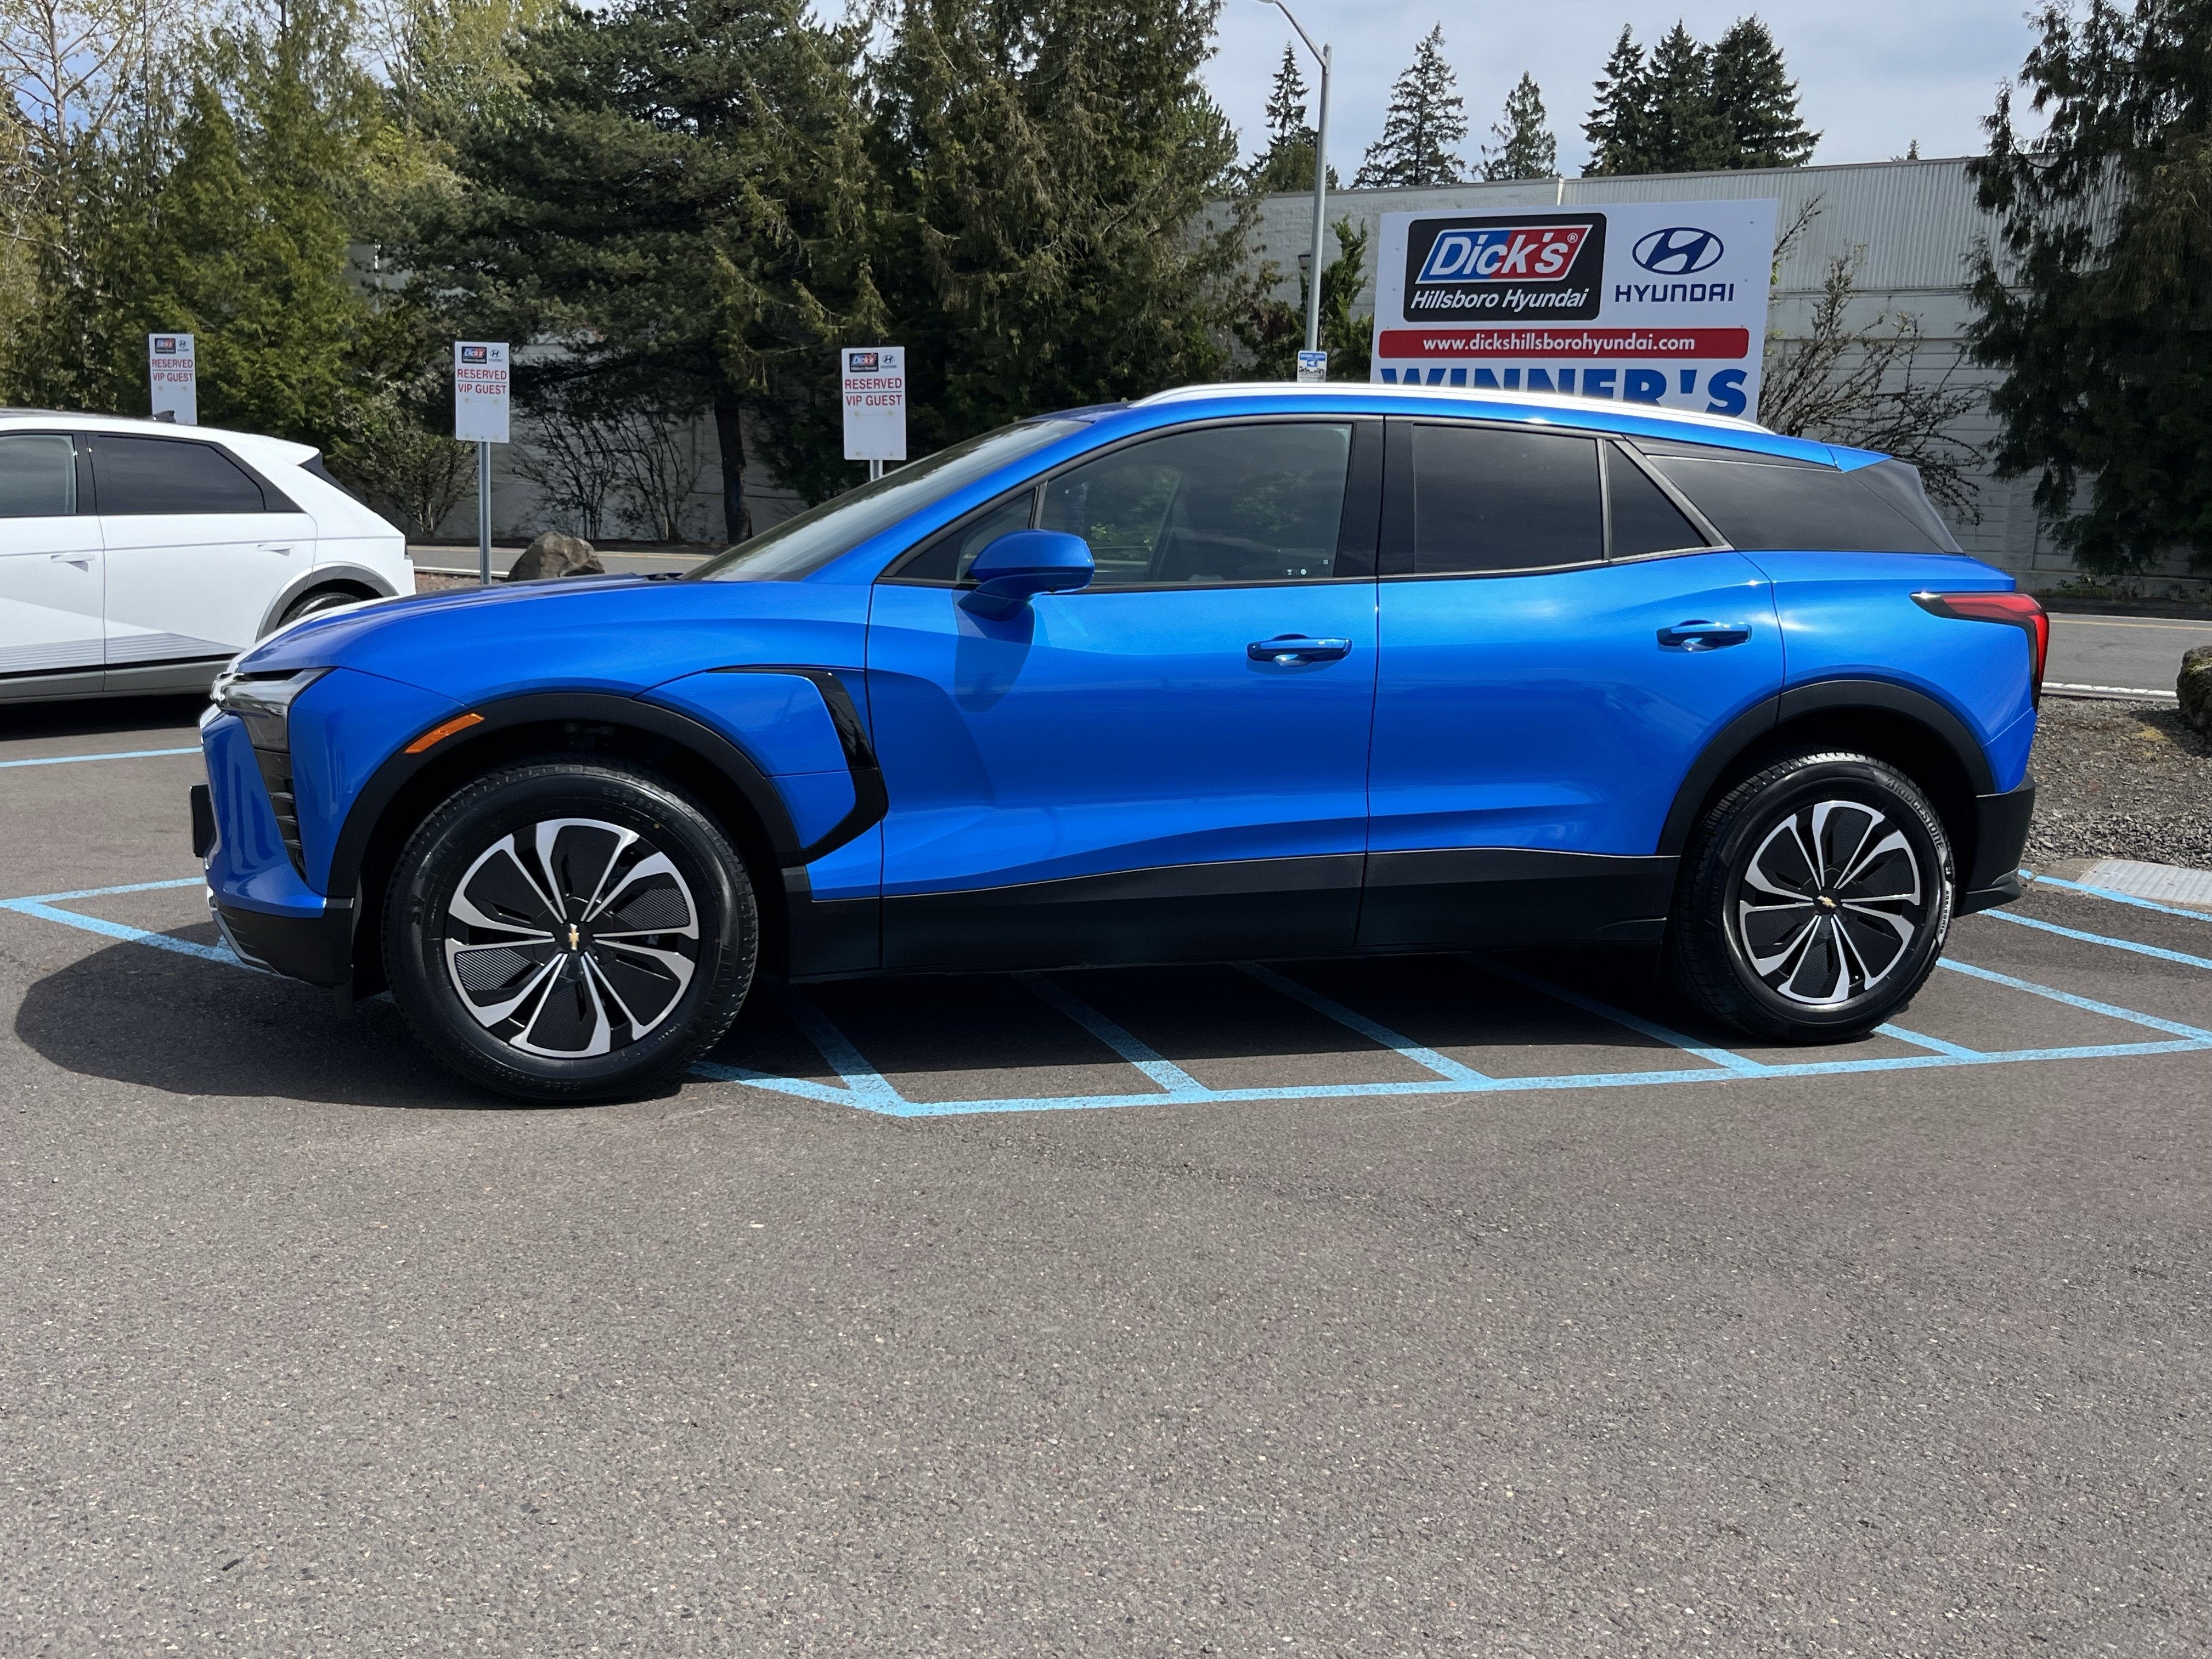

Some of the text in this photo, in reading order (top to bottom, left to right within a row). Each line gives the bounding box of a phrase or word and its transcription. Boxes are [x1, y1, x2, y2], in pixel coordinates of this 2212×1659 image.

[1615, 283, 1735, 303] HYUNDAI
[1410, 288, 1590, 312] Hillsboro Hyundai
[1423, 332, 1695, 355] www.dickshillsborohyundai.com
[152, 359, 193, 368] RESERVED
[153, 373, 193, 382] VIP GUEST
[457, 369, 507, 380] RESERVED
[458, 384, 506, 394] VIP GUEST
[845, 378, 902, 390] RESERVED
[846, 394, 902, 406] VIP GUEST
